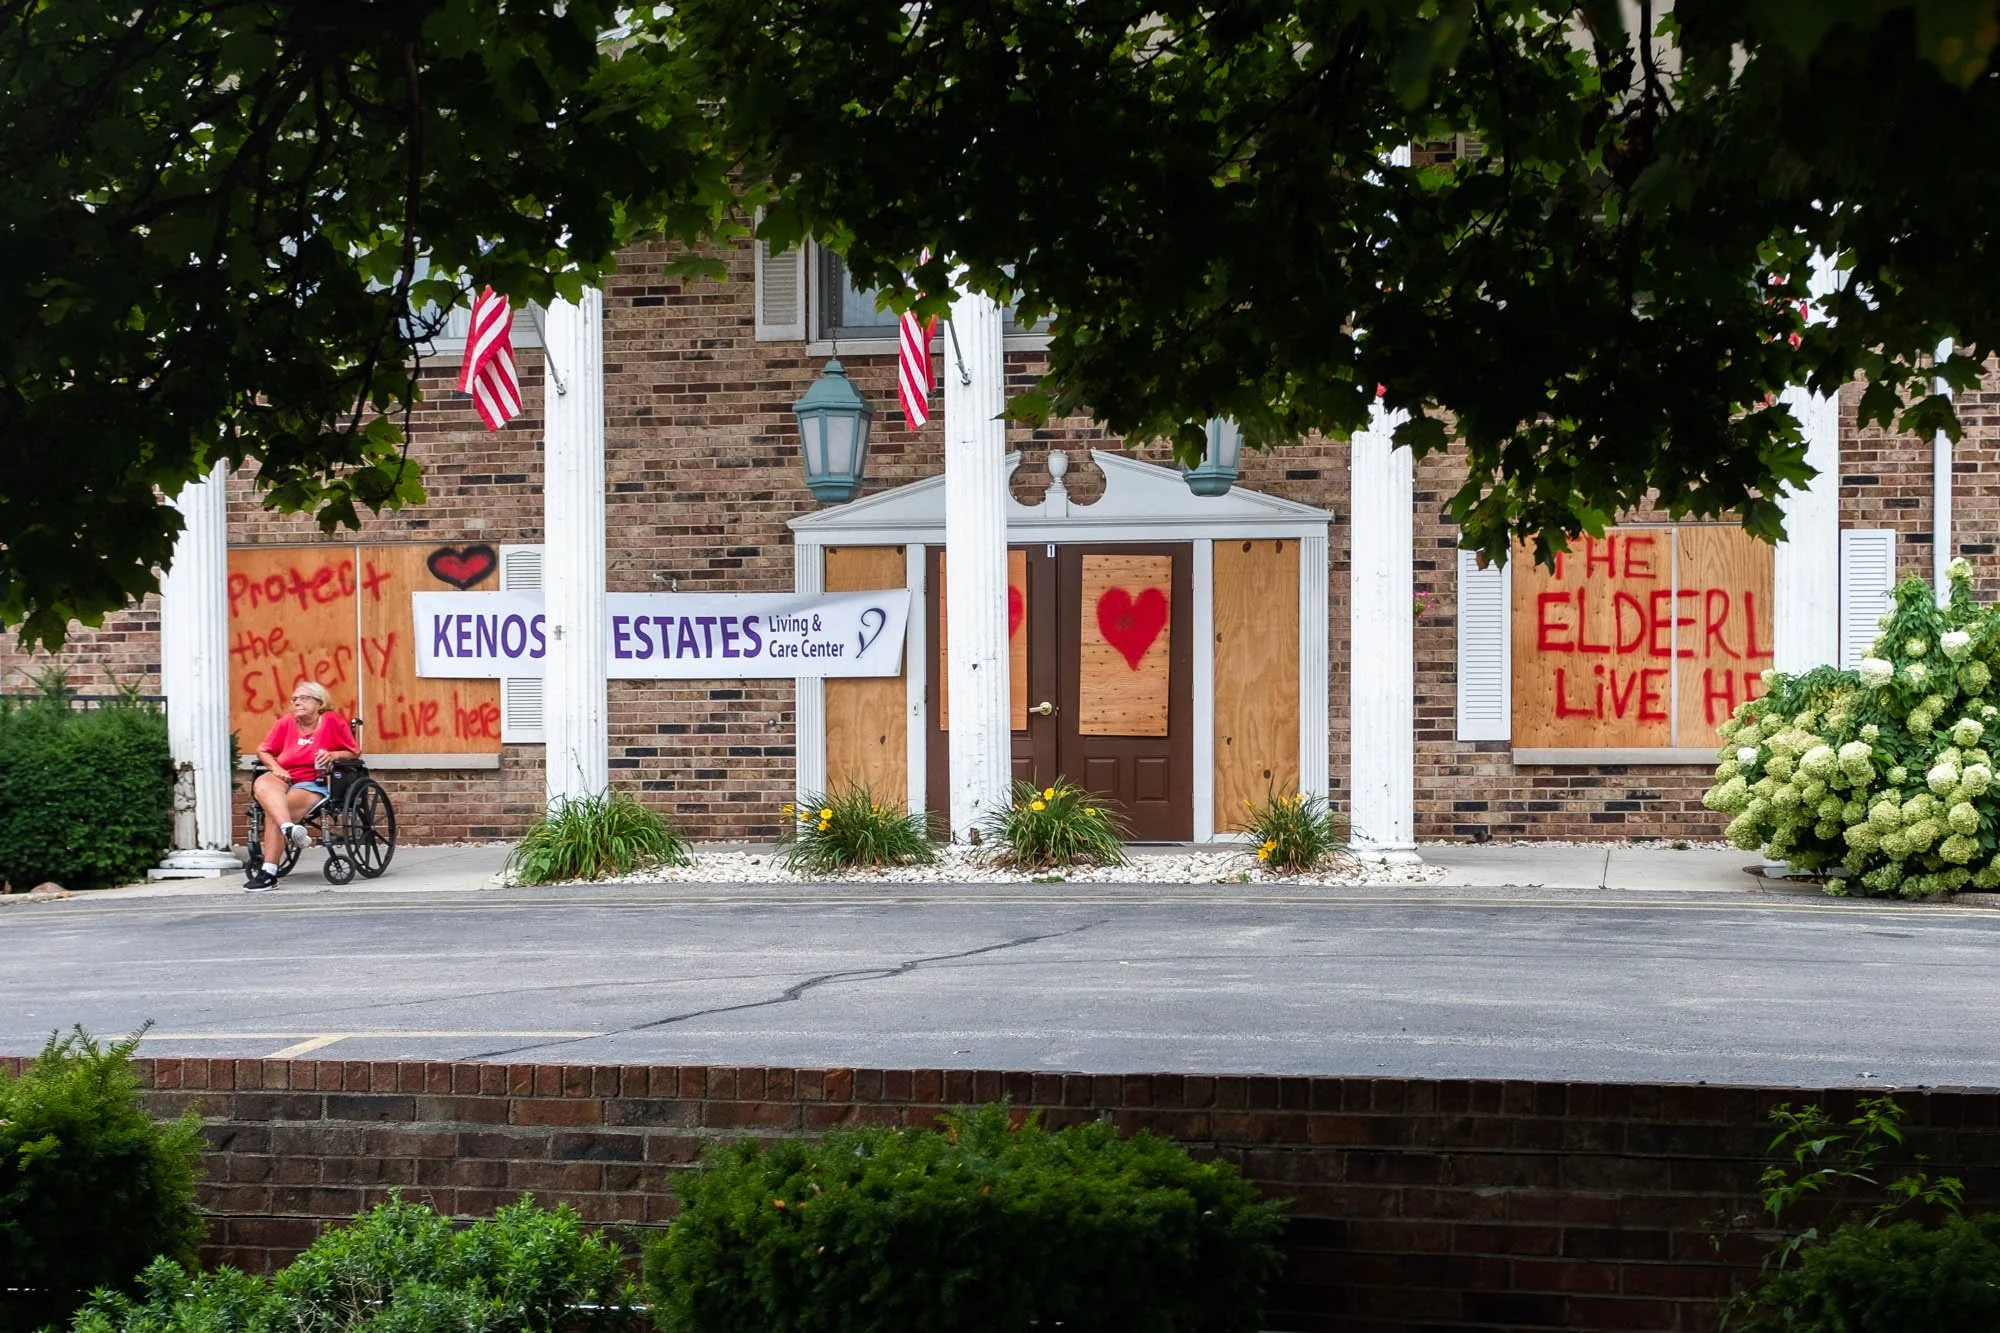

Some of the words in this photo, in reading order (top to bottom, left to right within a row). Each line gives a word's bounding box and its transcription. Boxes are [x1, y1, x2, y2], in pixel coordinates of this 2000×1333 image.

[433, 613, 546, 659] KENOS
[612, 615, 762, 659] ESTATES
[768, 614, 809, 637] Living
[812, 613, 822, 632] &
[1537, 587, 1774, 660] ELDERL
[230, 626, 290, 663] the
[769, 640, 798, 658] Care
[801, 639, 844, 658] Center
[376, 694, 441, 740] Live
[453, 690, 502, 740] here
